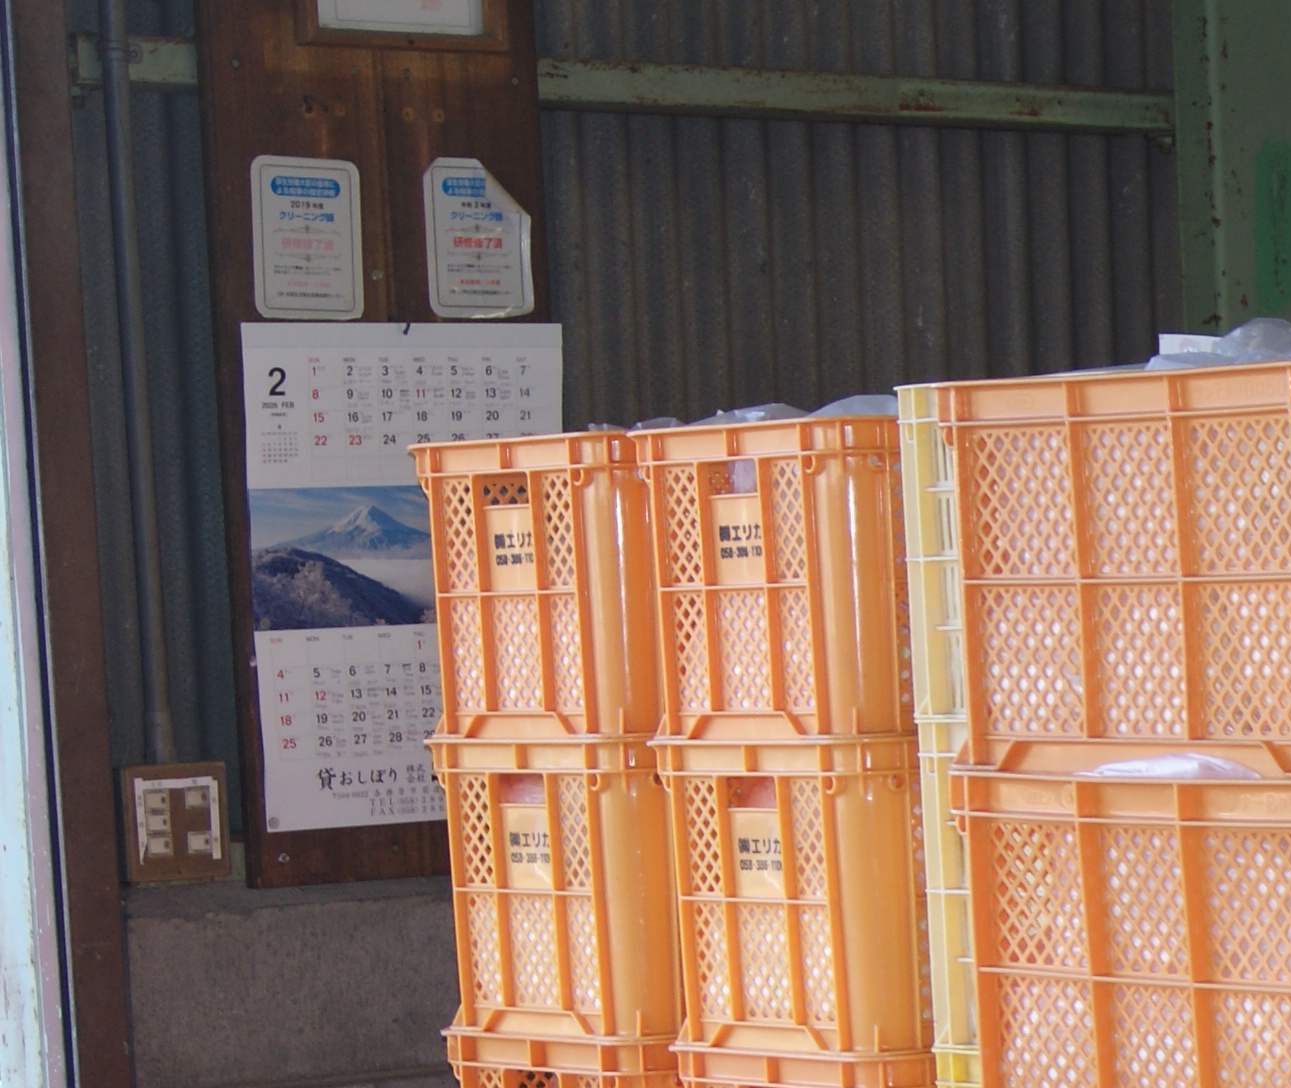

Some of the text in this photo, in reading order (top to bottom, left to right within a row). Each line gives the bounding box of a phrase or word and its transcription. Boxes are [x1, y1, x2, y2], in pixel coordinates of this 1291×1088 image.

[312, 365, 526, 376] 1 2 3 4 5 6 7
[268, 367, 286, 396] 2
[312, 388, 530, 399] 8 9 10 11 12 13 14
[314, 410, 531, 422] 15 16 17 18 19 20 21
[314, 435, 327, 446] 22
[349, 435, 362, 445] 23
[383, 434, 396, 445] 24
[417, 434, 430, 443] 25
[417, 640, 421, 649] 1
[277, 662, 426, 678] 4 5 6 7 8
[279, 685, 432, 701] 11 12 13 14 15
[280, 708, 435, 725] 18 19 20 21 22
[282, 738, 296, 749] 25
[319, 736, 332, 746] 26
[354, 734, 367, 744] 27
[389, 732, 402, 742] 28
[318, 768, 397, 790] 貸おしぼり
